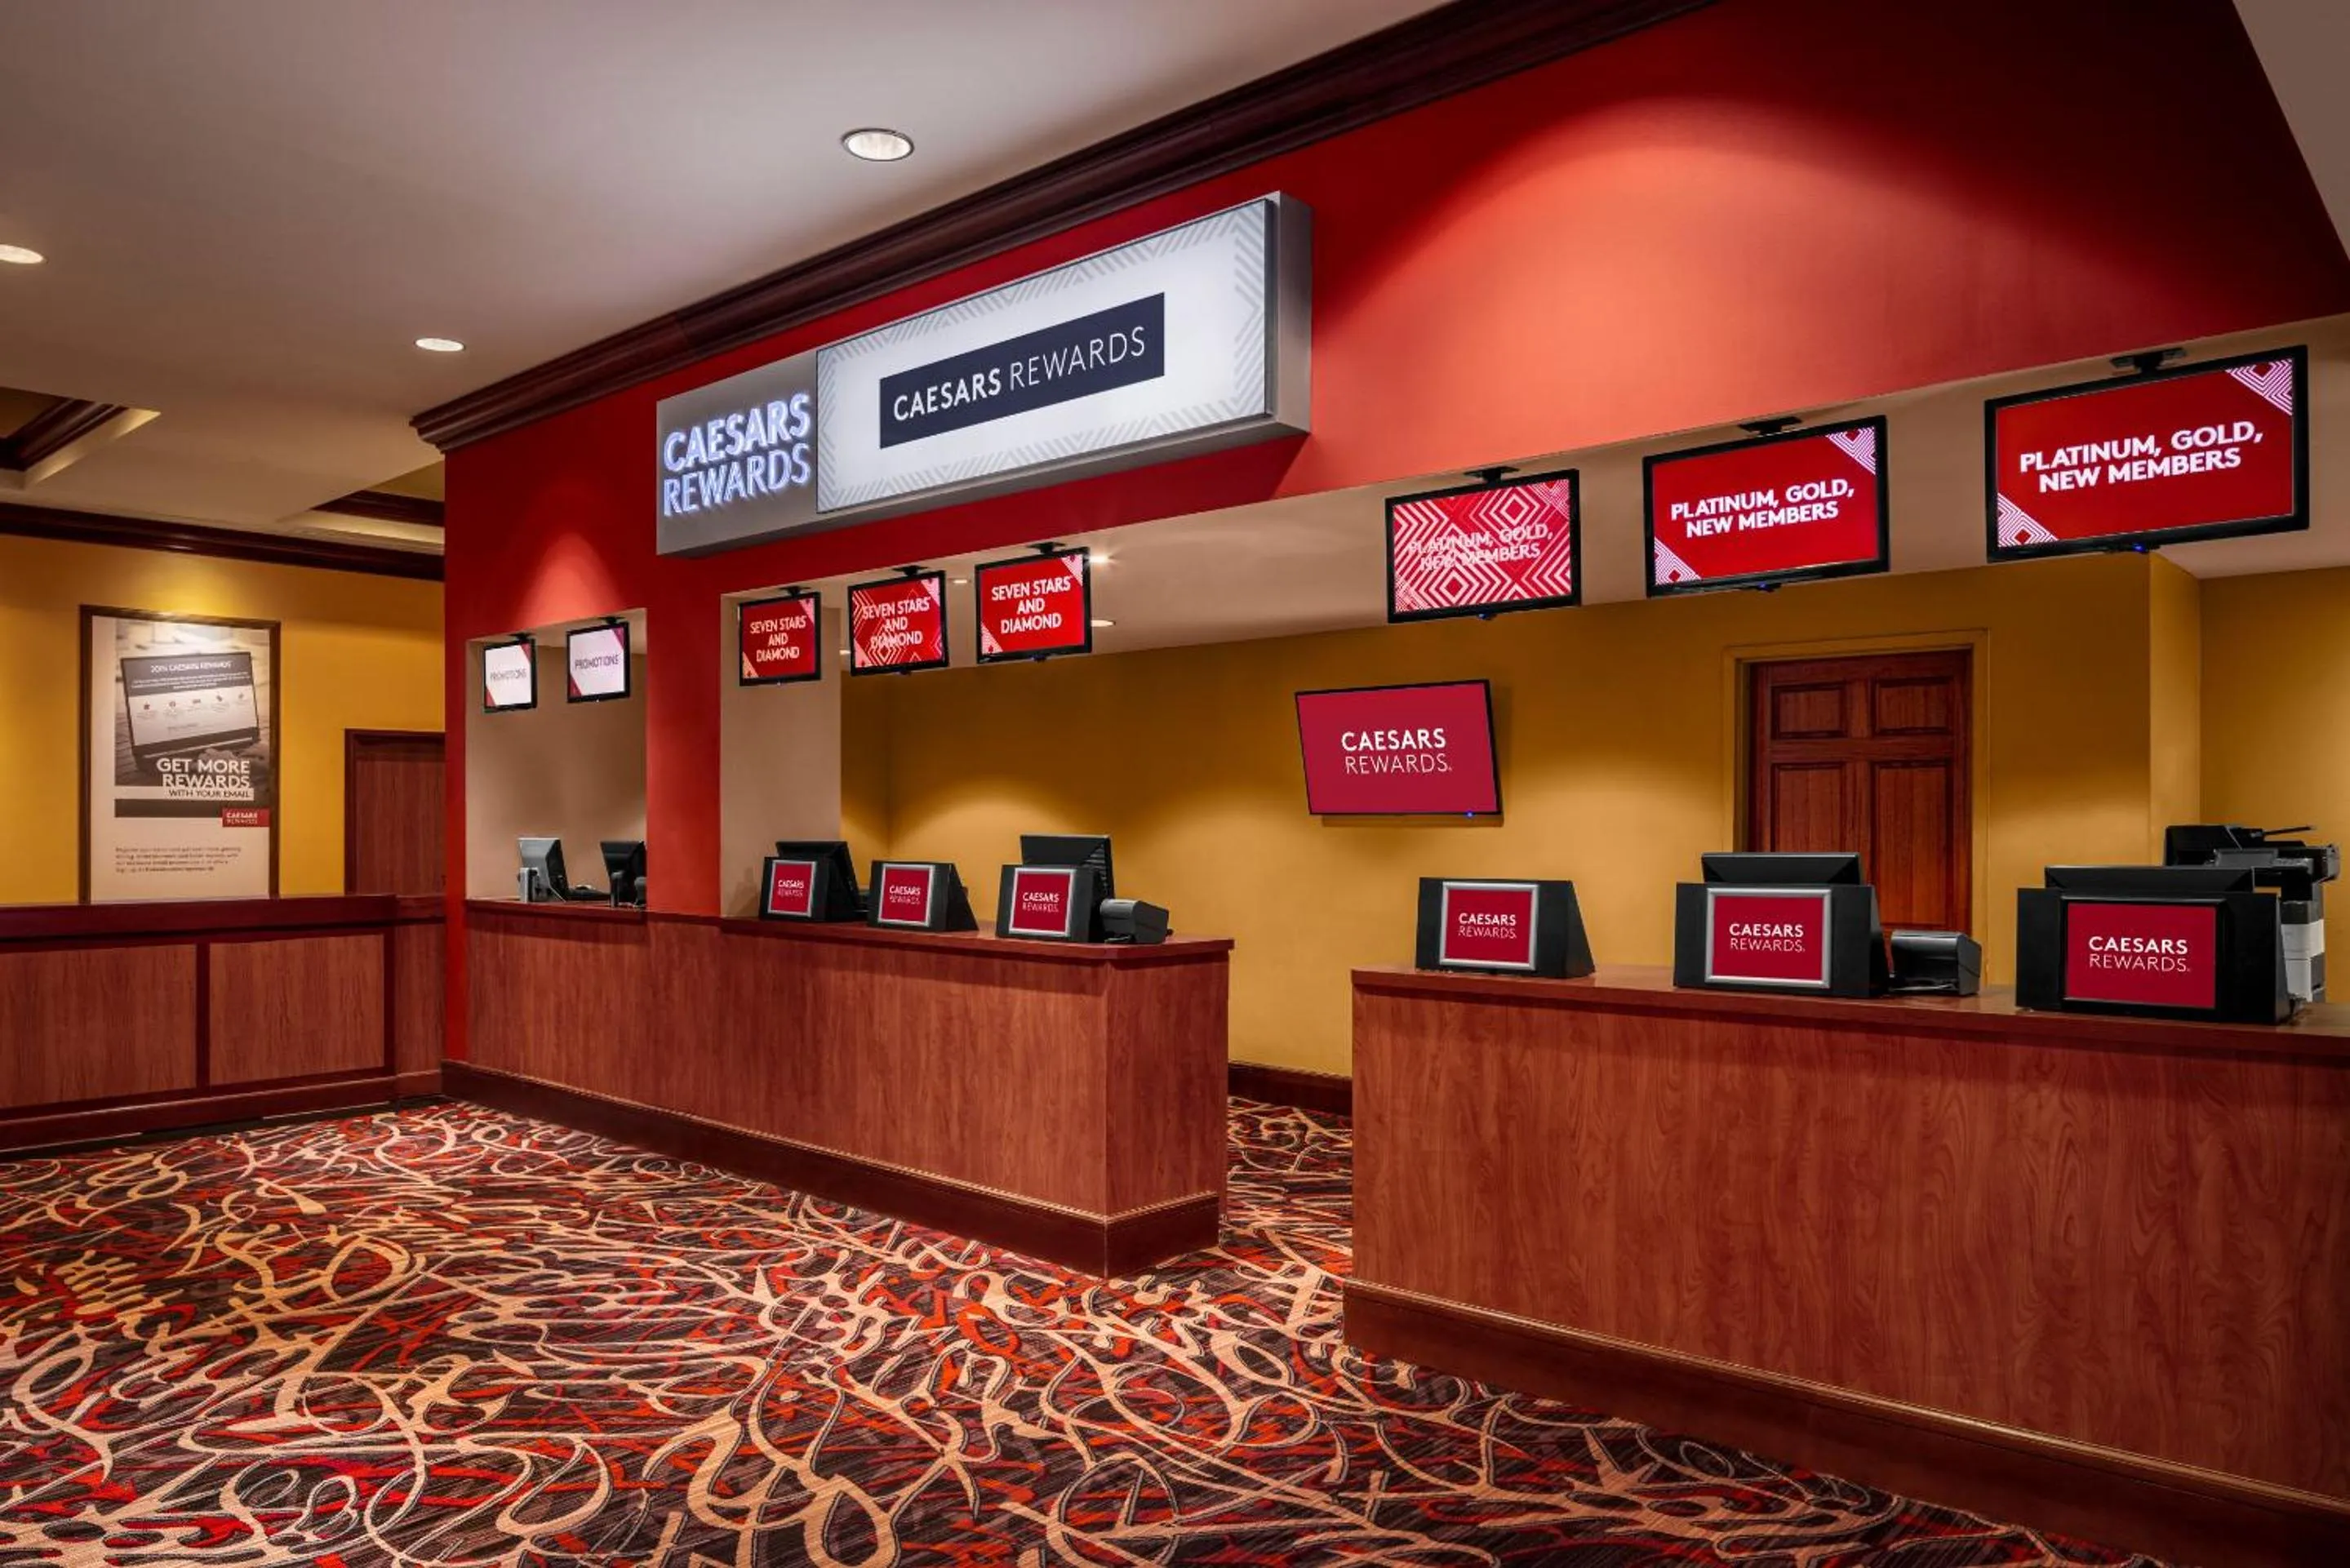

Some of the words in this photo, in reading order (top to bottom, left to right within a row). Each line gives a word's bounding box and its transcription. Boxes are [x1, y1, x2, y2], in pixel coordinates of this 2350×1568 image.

[894, 368, 1001, 421] CAESARS
[1010, 326, 1145, 391] REWARDS
[664, 393, 811, 472] CAESARS
[2020, 434, 2161, 473] PLATINUM,
[2170, 420, 2263, 451] GOLD,
[2039, 466, 2101, 493] NEW
[2108, 447, 2241, 484] MEMBERS
[664, 442, 811, 517] REWARDS
[1671, 489, 1779, 520] PLATINUM,
[1785, 478, 1855, 503] GOLD,
[1686, 515, 1734, 538] NEW
[1739, 501, 1838, 531] MEMBERS
[1499, 523, 1553, 541] GOLD,
[1460, 543, 1541, 566] MEMBERS
[991, 582, 1030, 601] SEVEN
[1033, 576, 1071, 597] STARS
[863, 602, 895, 620] SEVEN
[898, 597, 931, 615] STARS
[1017, 597, 1045, 615] AND
[750, 619, 778, 634] SEVEN
[780, 615, 806, 630] STARS
[885, 616, 908, 632] AND
[1001, 612, 1062, 634] DIAMOND
[767, 633, 789, 647] AND
[870, 631, 923, 650] DIAMOND
[575, 654, 620, 670] PROMOTIONS
[756, 646, 800, 662] DIAMOND
[1341, 728, 1446, 752] CAESARS
[157, 757, 192, 772] GET
[198, 759, 250, 774] MORE
[162, 774, 250, 788] REWARDS
[169, 789, 193, 797] WITH
[196, 789, 221, 797] YOUR
[224, 789, 249, 797] EMAIL
[778, 879, 804, 889] CAESARS
[889, 886, 922, 895] CAESARS
[1023, 891, 1059, 903] CAESARS
[1459, 913, 1517, 926] CAESARS
[1729, 923, 1804, 938] CAESARS
[2089, 936, 2188, 954] CAESARS
